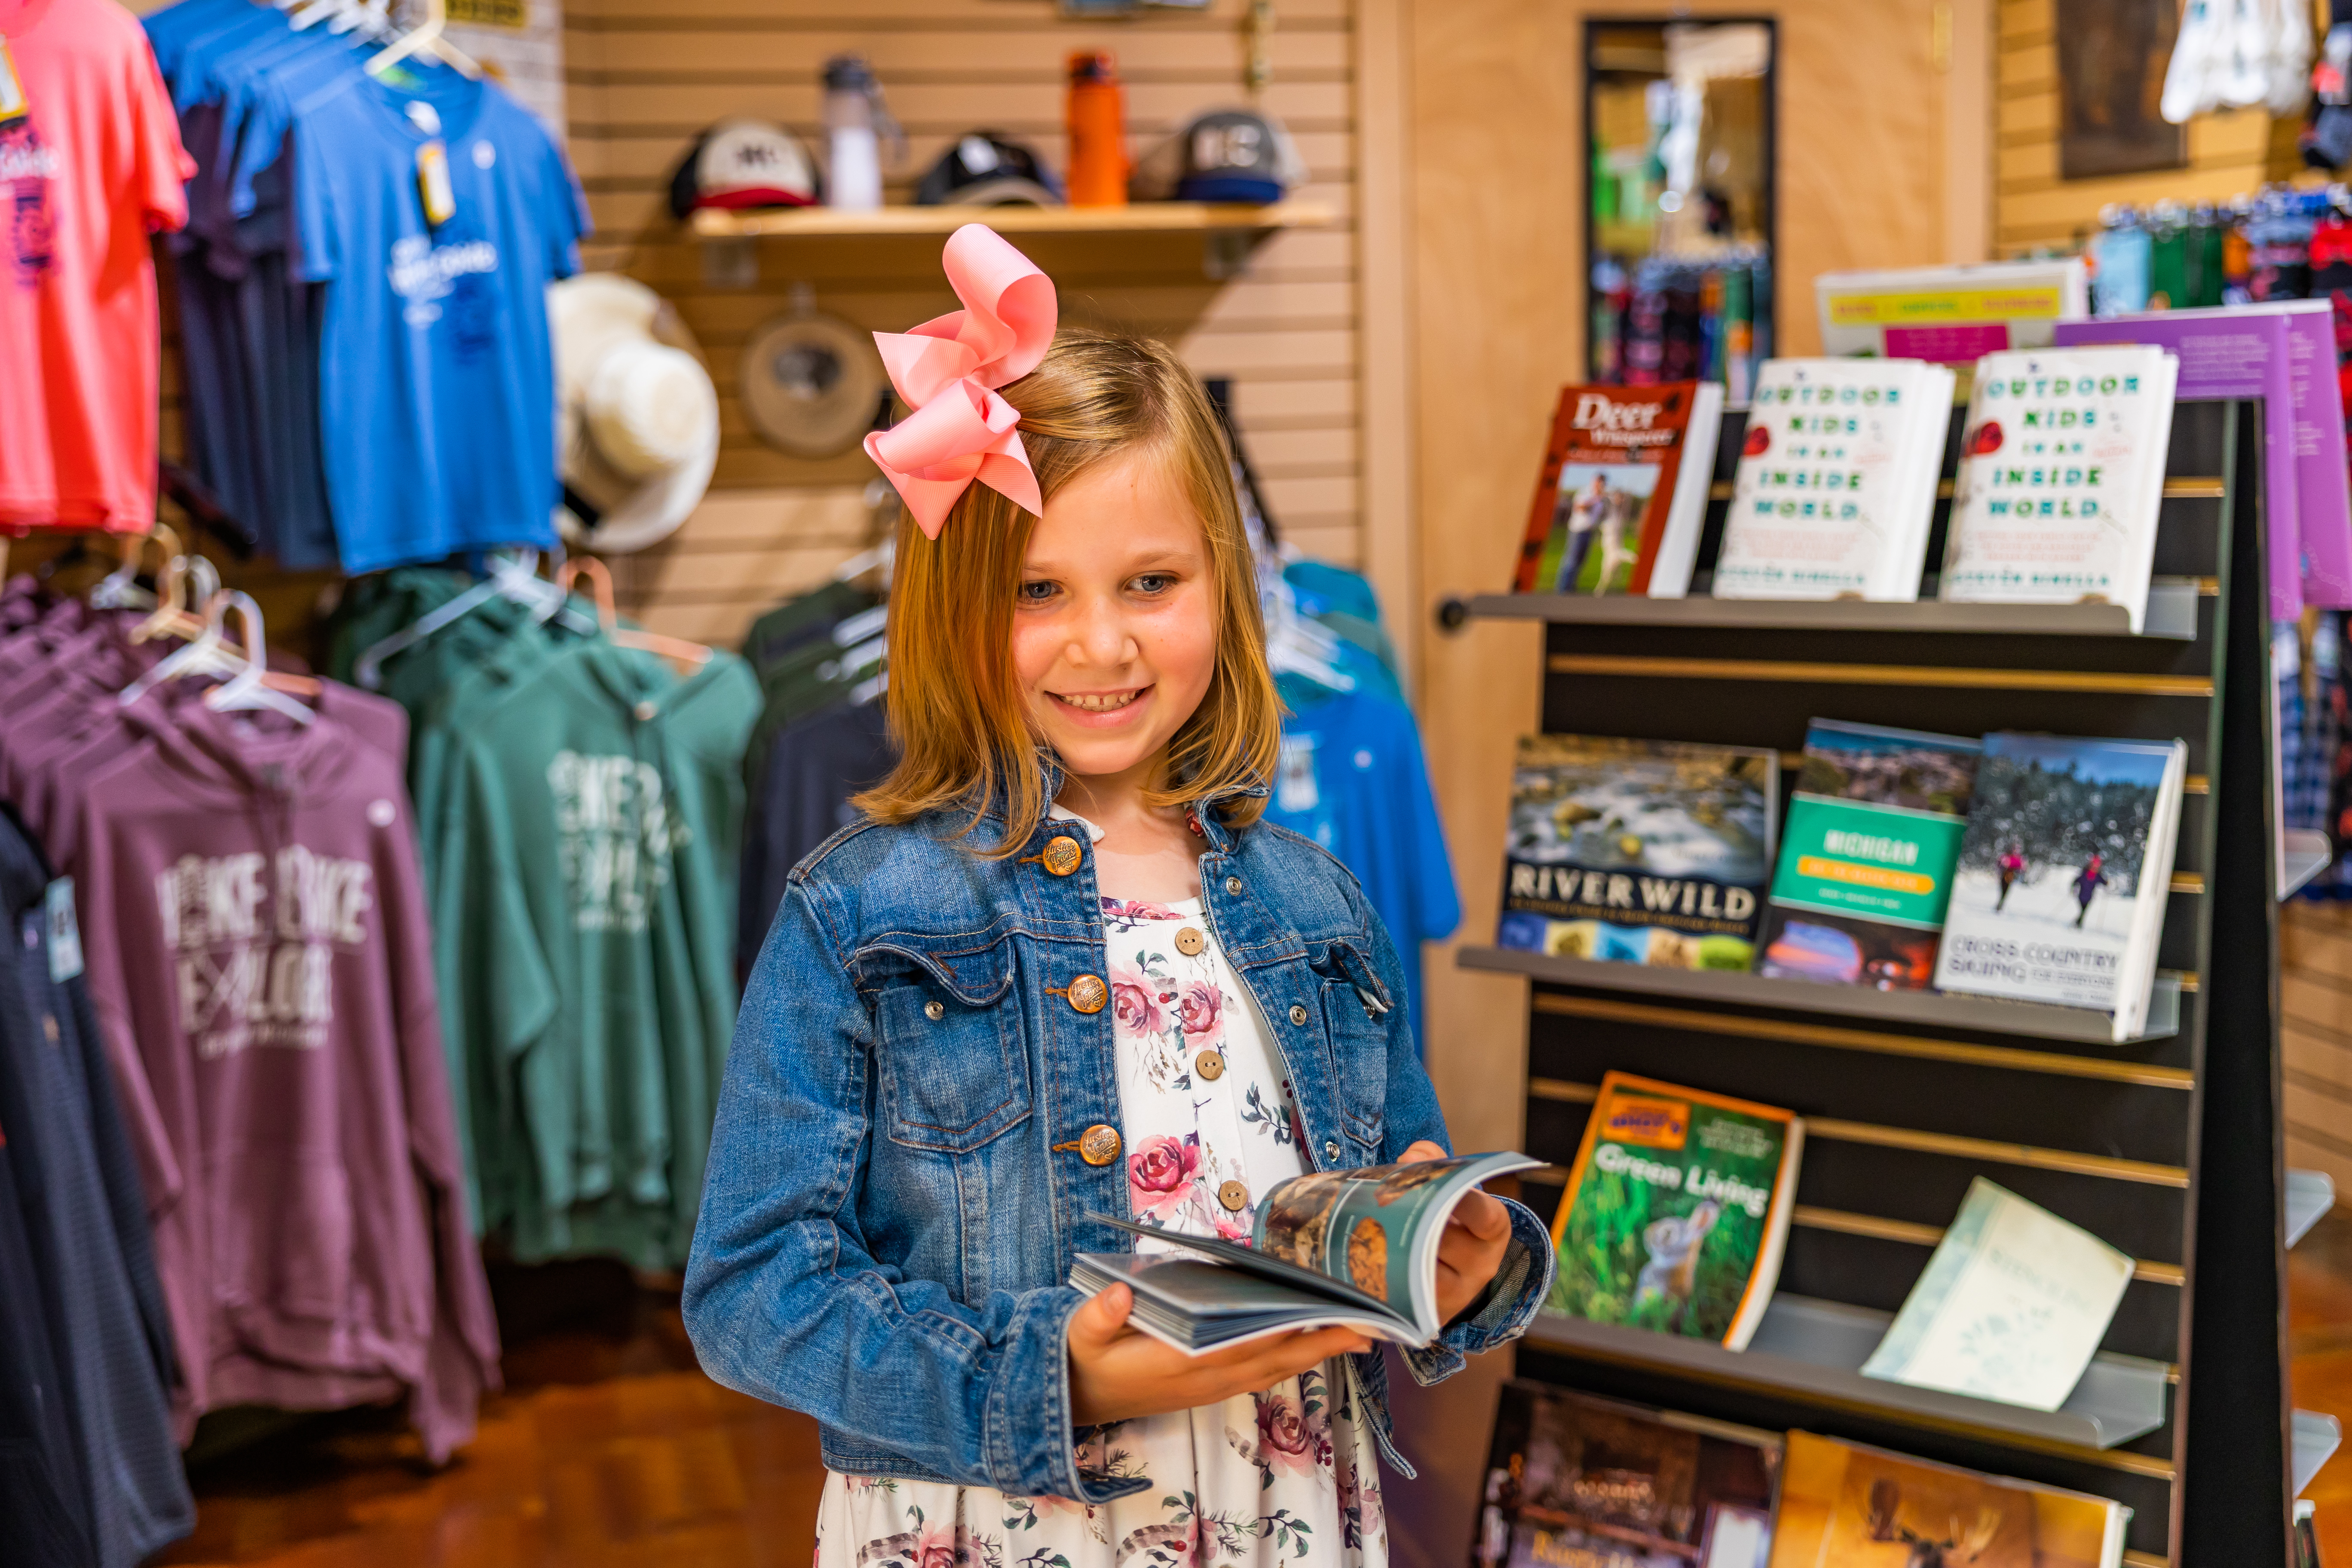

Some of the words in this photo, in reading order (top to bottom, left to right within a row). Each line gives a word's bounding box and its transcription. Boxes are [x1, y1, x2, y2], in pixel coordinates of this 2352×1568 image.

[1758, 386, 1901, 406] OUTDOOR
[1988, 376, 2139, 398] OUTDOOR
[1571, 393, 1663, 431] Deer
[2024, 410, 2096, 427] KIDS
[1790, 416, 1858, 433] KIDS
[1760, 469, 1862, 490] INSIDE
[1993, 467, 2104, 487] INSIDE
[1754, 499, 1859, 519] WORLD
[1989, 498, 2099, 518] WORLD
[1045, 842, 1075, 860] Justice
[1824, 829, 1919, 866] MICHIGAN
[1051, 850, 1076, 872] Jeans
[1510, 862, 1634, 908] RIVER
[1638, 876, 1756, 921] WILD
[1951, 934, 2019, 959] CROSS
[2024, 942, 2117, 972] COUNTRY
[1949, 957, 2026, 984] SKIING
[1072, 979, 1100, 999] Justice
[1078, 984, 1102, 1009] Jeans
[1083, 1130, 1115, 1150] Justice
[1090, 1137, 1115, 1161] Jeans
[1595, 1143, 1682, 1190] Green
[1685, 1164, 1769, 1218] Living
